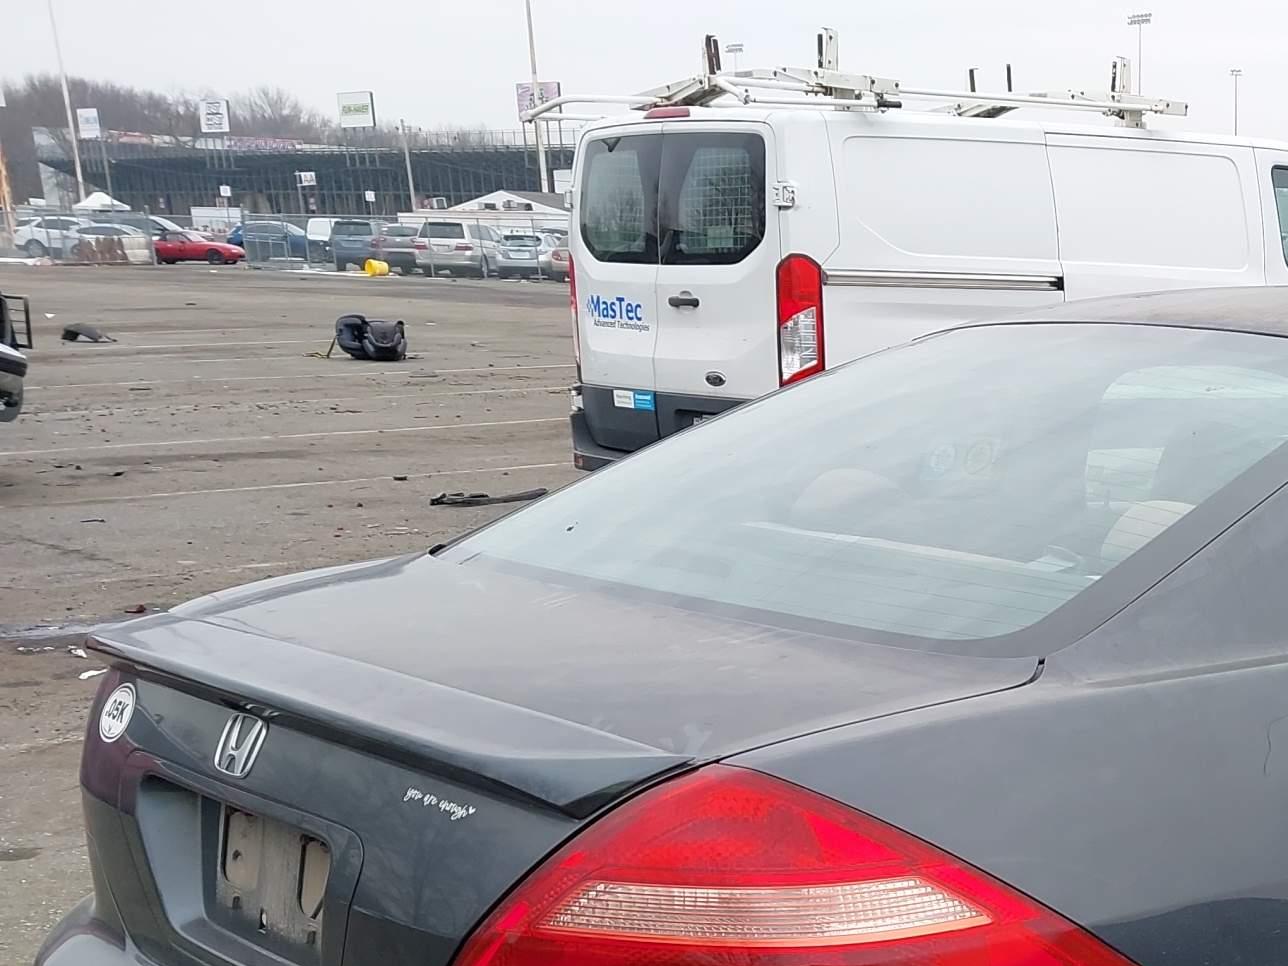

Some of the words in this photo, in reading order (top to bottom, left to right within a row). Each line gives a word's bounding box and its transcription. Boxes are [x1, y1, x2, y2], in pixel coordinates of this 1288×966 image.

[590, 294, 643, 321] MasTec
[593, 319, 616, 328] Advanced
[617, 320, 650, 332] Technologies
[403, 787, 424, 802] you
[438, 799, 468, 821] enough
